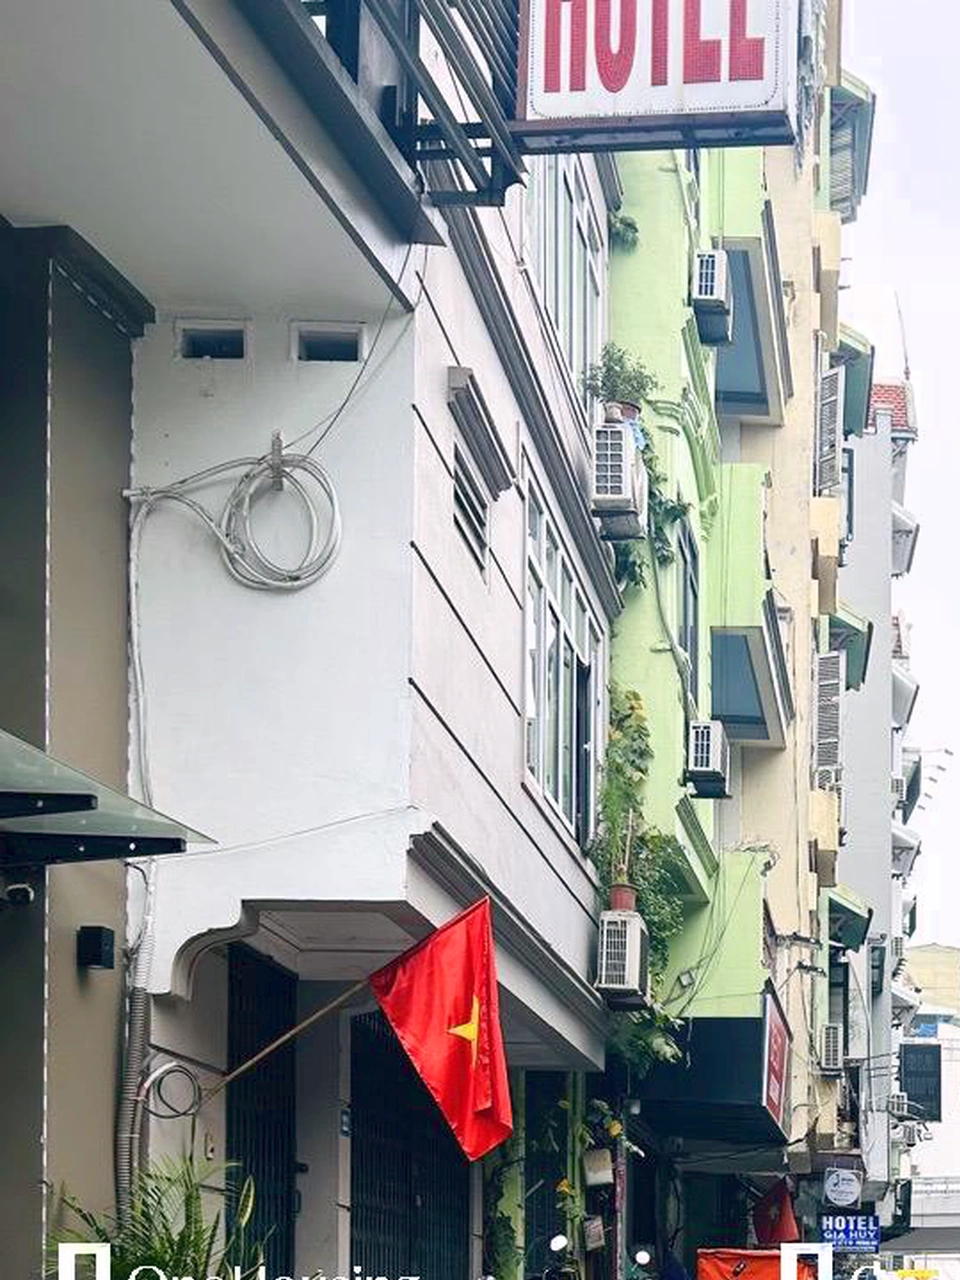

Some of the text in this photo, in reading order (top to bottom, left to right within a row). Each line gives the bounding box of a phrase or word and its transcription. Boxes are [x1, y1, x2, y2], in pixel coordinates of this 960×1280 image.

[822, 1215, 878, 1230] HOTEL
[823, 1230, 876, 1239] GIA HUY
